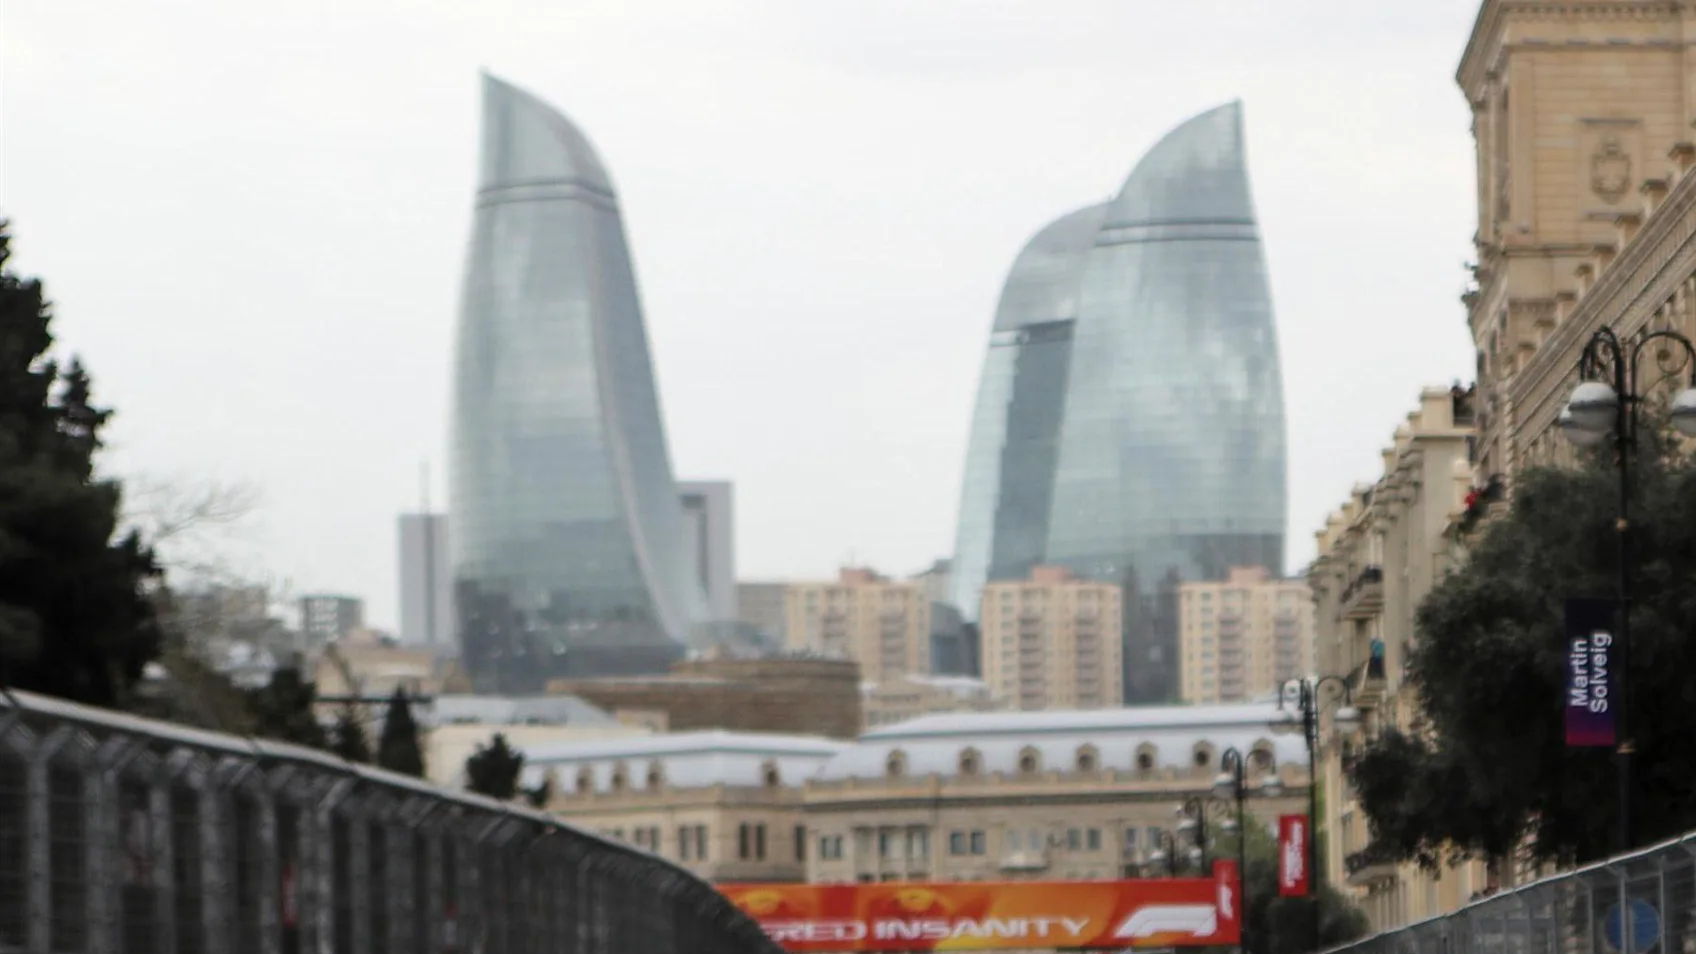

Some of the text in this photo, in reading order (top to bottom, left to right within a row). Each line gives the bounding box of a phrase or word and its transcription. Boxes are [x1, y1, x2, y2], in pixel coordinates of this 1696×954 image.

[1569, 638, 1589, 707] Martin
[1589, 631, 1613, 713] Solveig
[875, 916, 1090, 940] INSANITY
